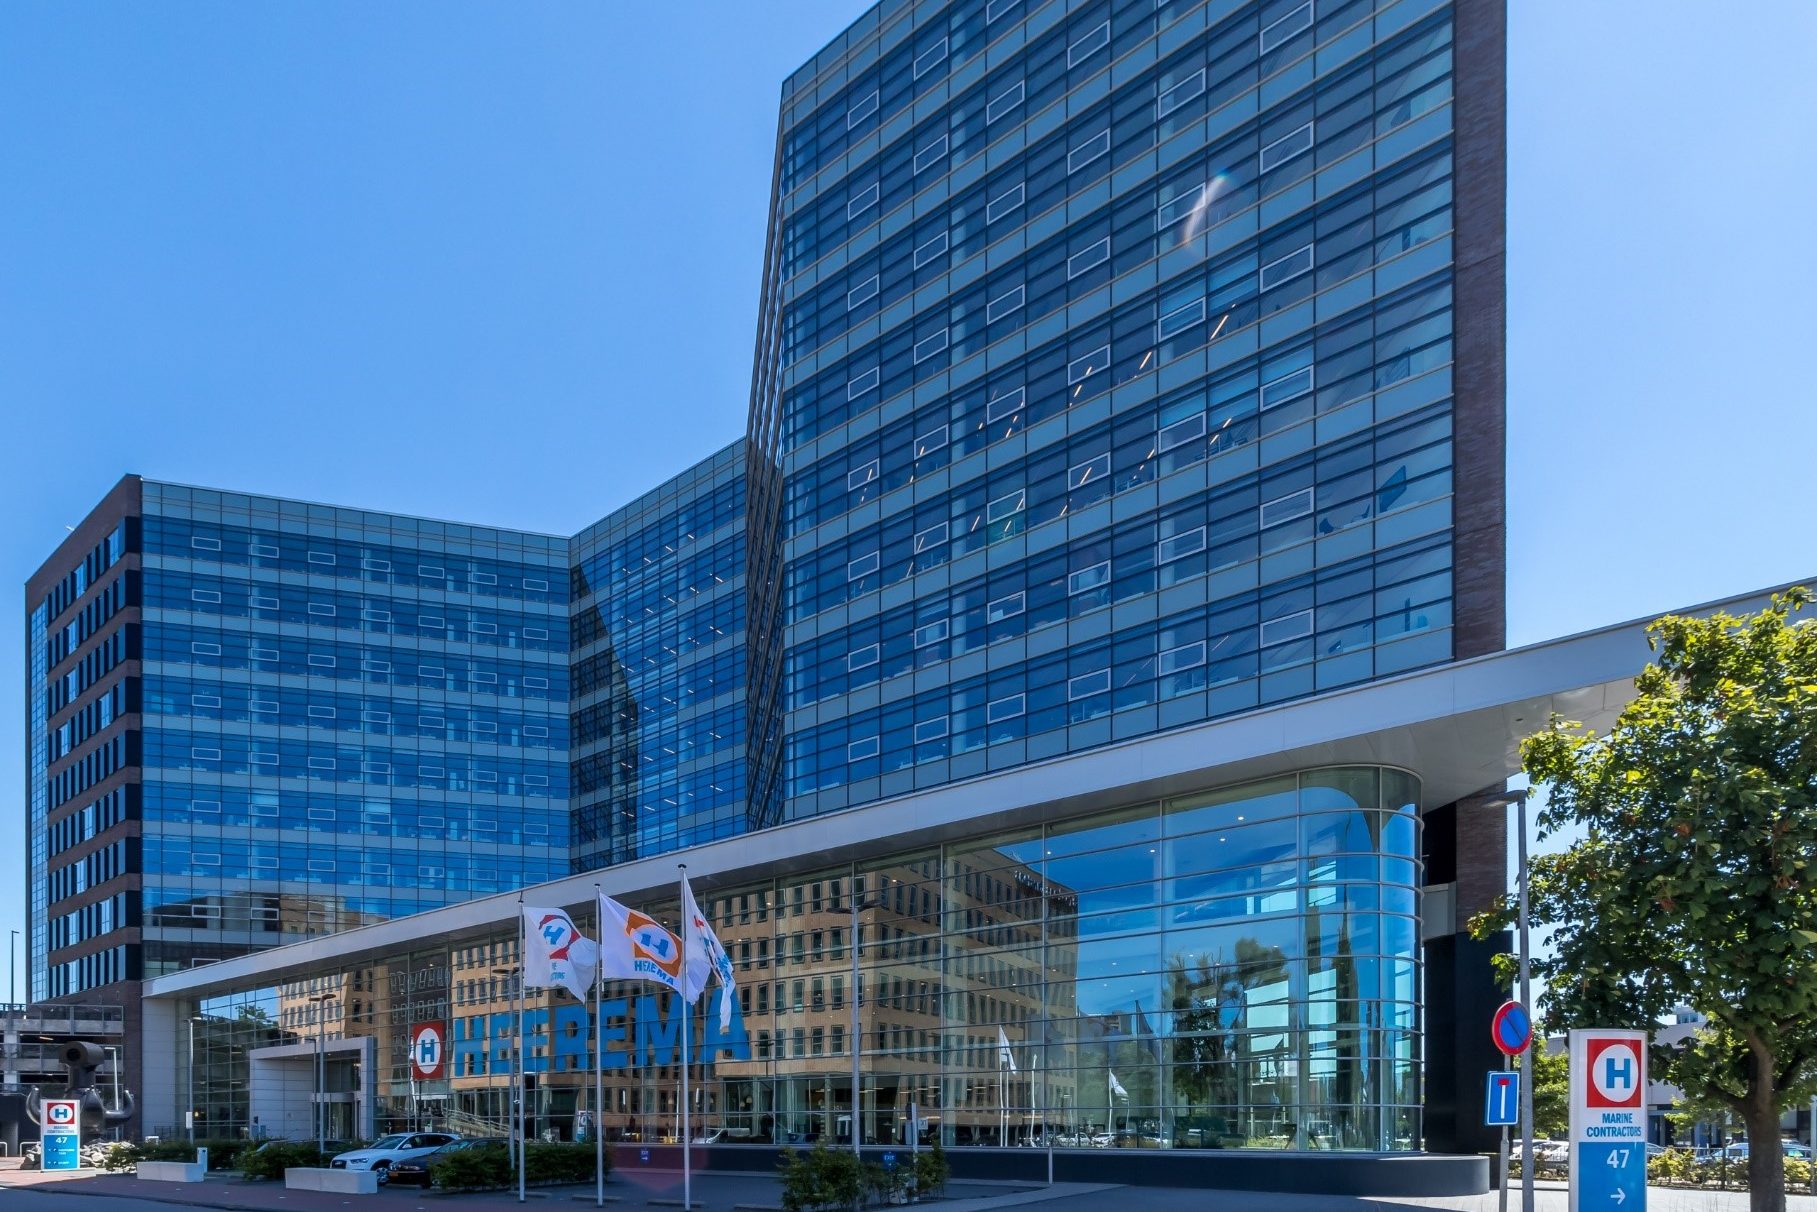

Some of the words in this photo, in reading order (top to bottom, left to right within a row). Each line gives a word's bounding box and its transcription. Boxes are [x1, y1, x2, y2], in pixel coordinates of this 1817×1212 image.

[543, 925, 565, 945] H
[640, 933, 669, 957] H
[421, 1039, 435, 1063] H
[1606, 1058, 1631, 1089] H
[54, 1108, 68, 1118] H
[1602, 1113, 1633, 1124] MARINE
[55, 1136, 68, 1144] 47
[1586, 1126, 1642, 1138] CONTRACTORS
[1606, 1149, 1630, 1169] 47
